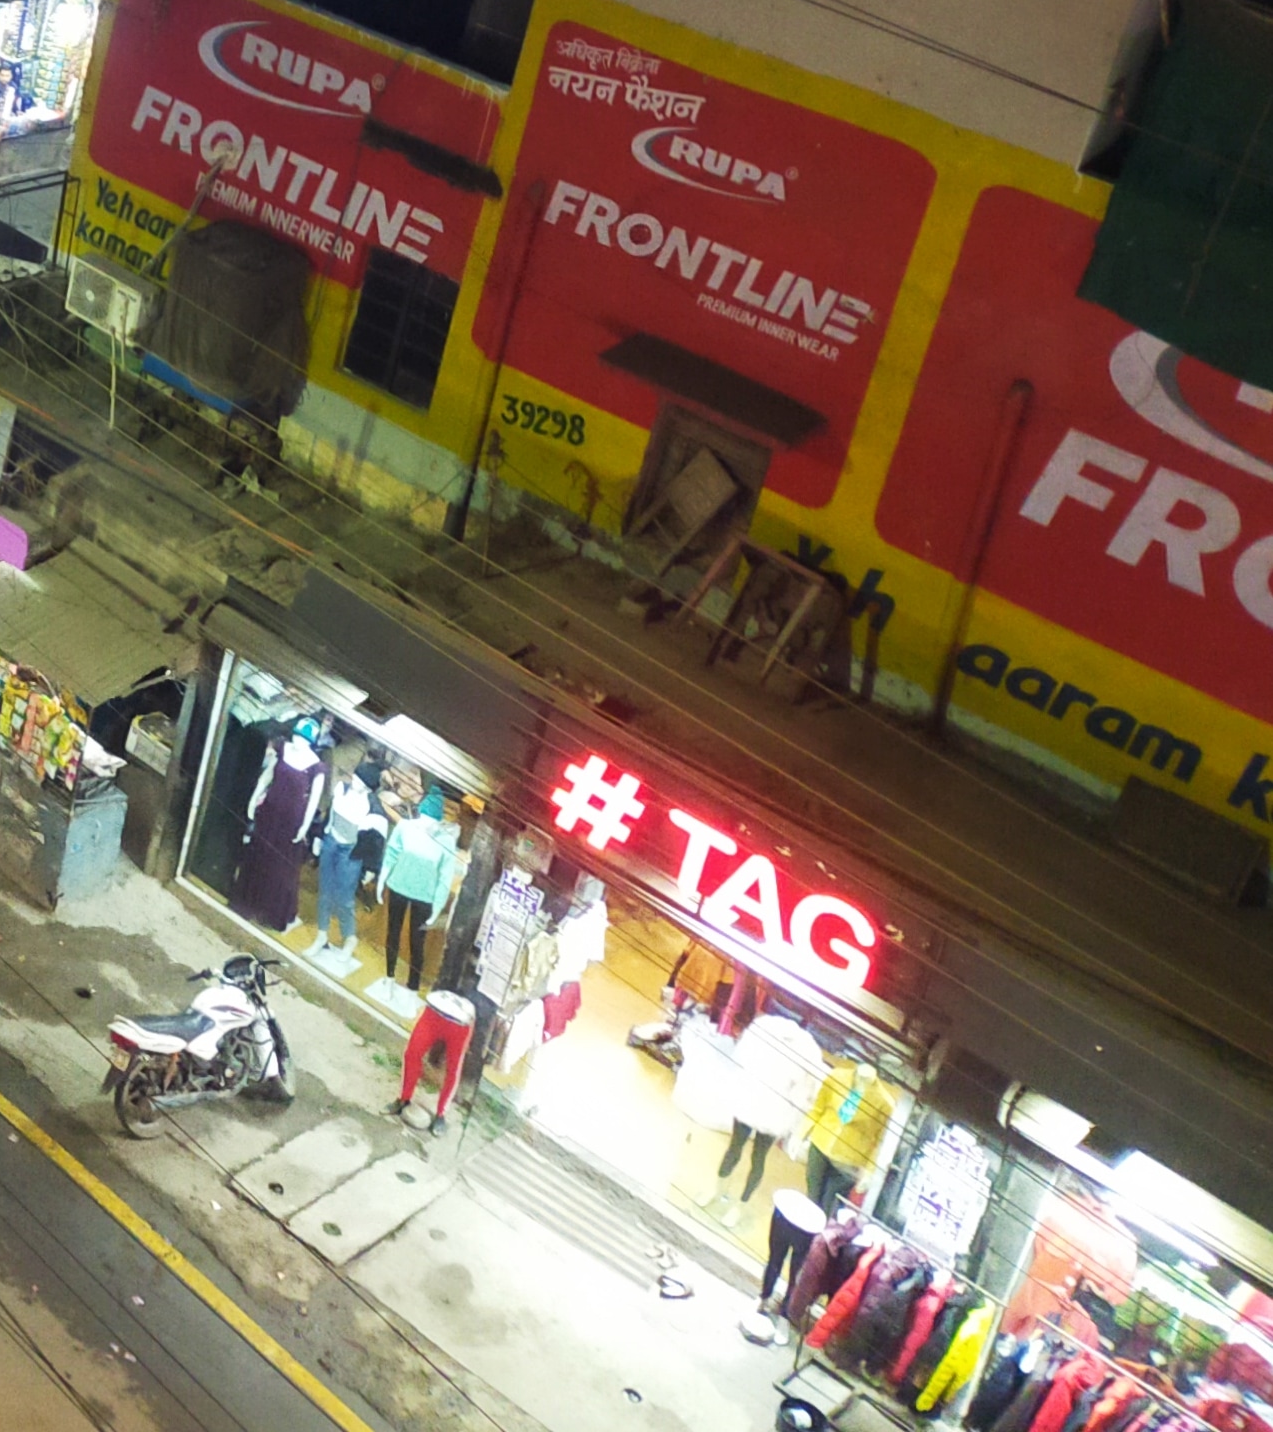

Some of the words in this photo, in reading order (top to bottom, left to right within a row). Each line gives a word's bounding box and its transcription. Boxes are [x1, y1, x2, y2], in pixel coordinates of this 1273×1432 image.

[241, 33, 372, 115] RUPA
[549, 66, 623, 106] नयन
[131, 85, 444, 263] FRONTLINE
[669, 135, 786, 202] RUPA
[543, 180, 873, 345] FRONTLINE
[697, 293, 757, 331] PREMIUM
[501, 394, 586, 446] 39298
[1018, 427, 1273, 628] FR
[797, 534, 895, 633] Yh
[957, 644, 1204, 785] aaram
[551, 754, 645, 850] #
[668, 807, 876, 990] TAG
